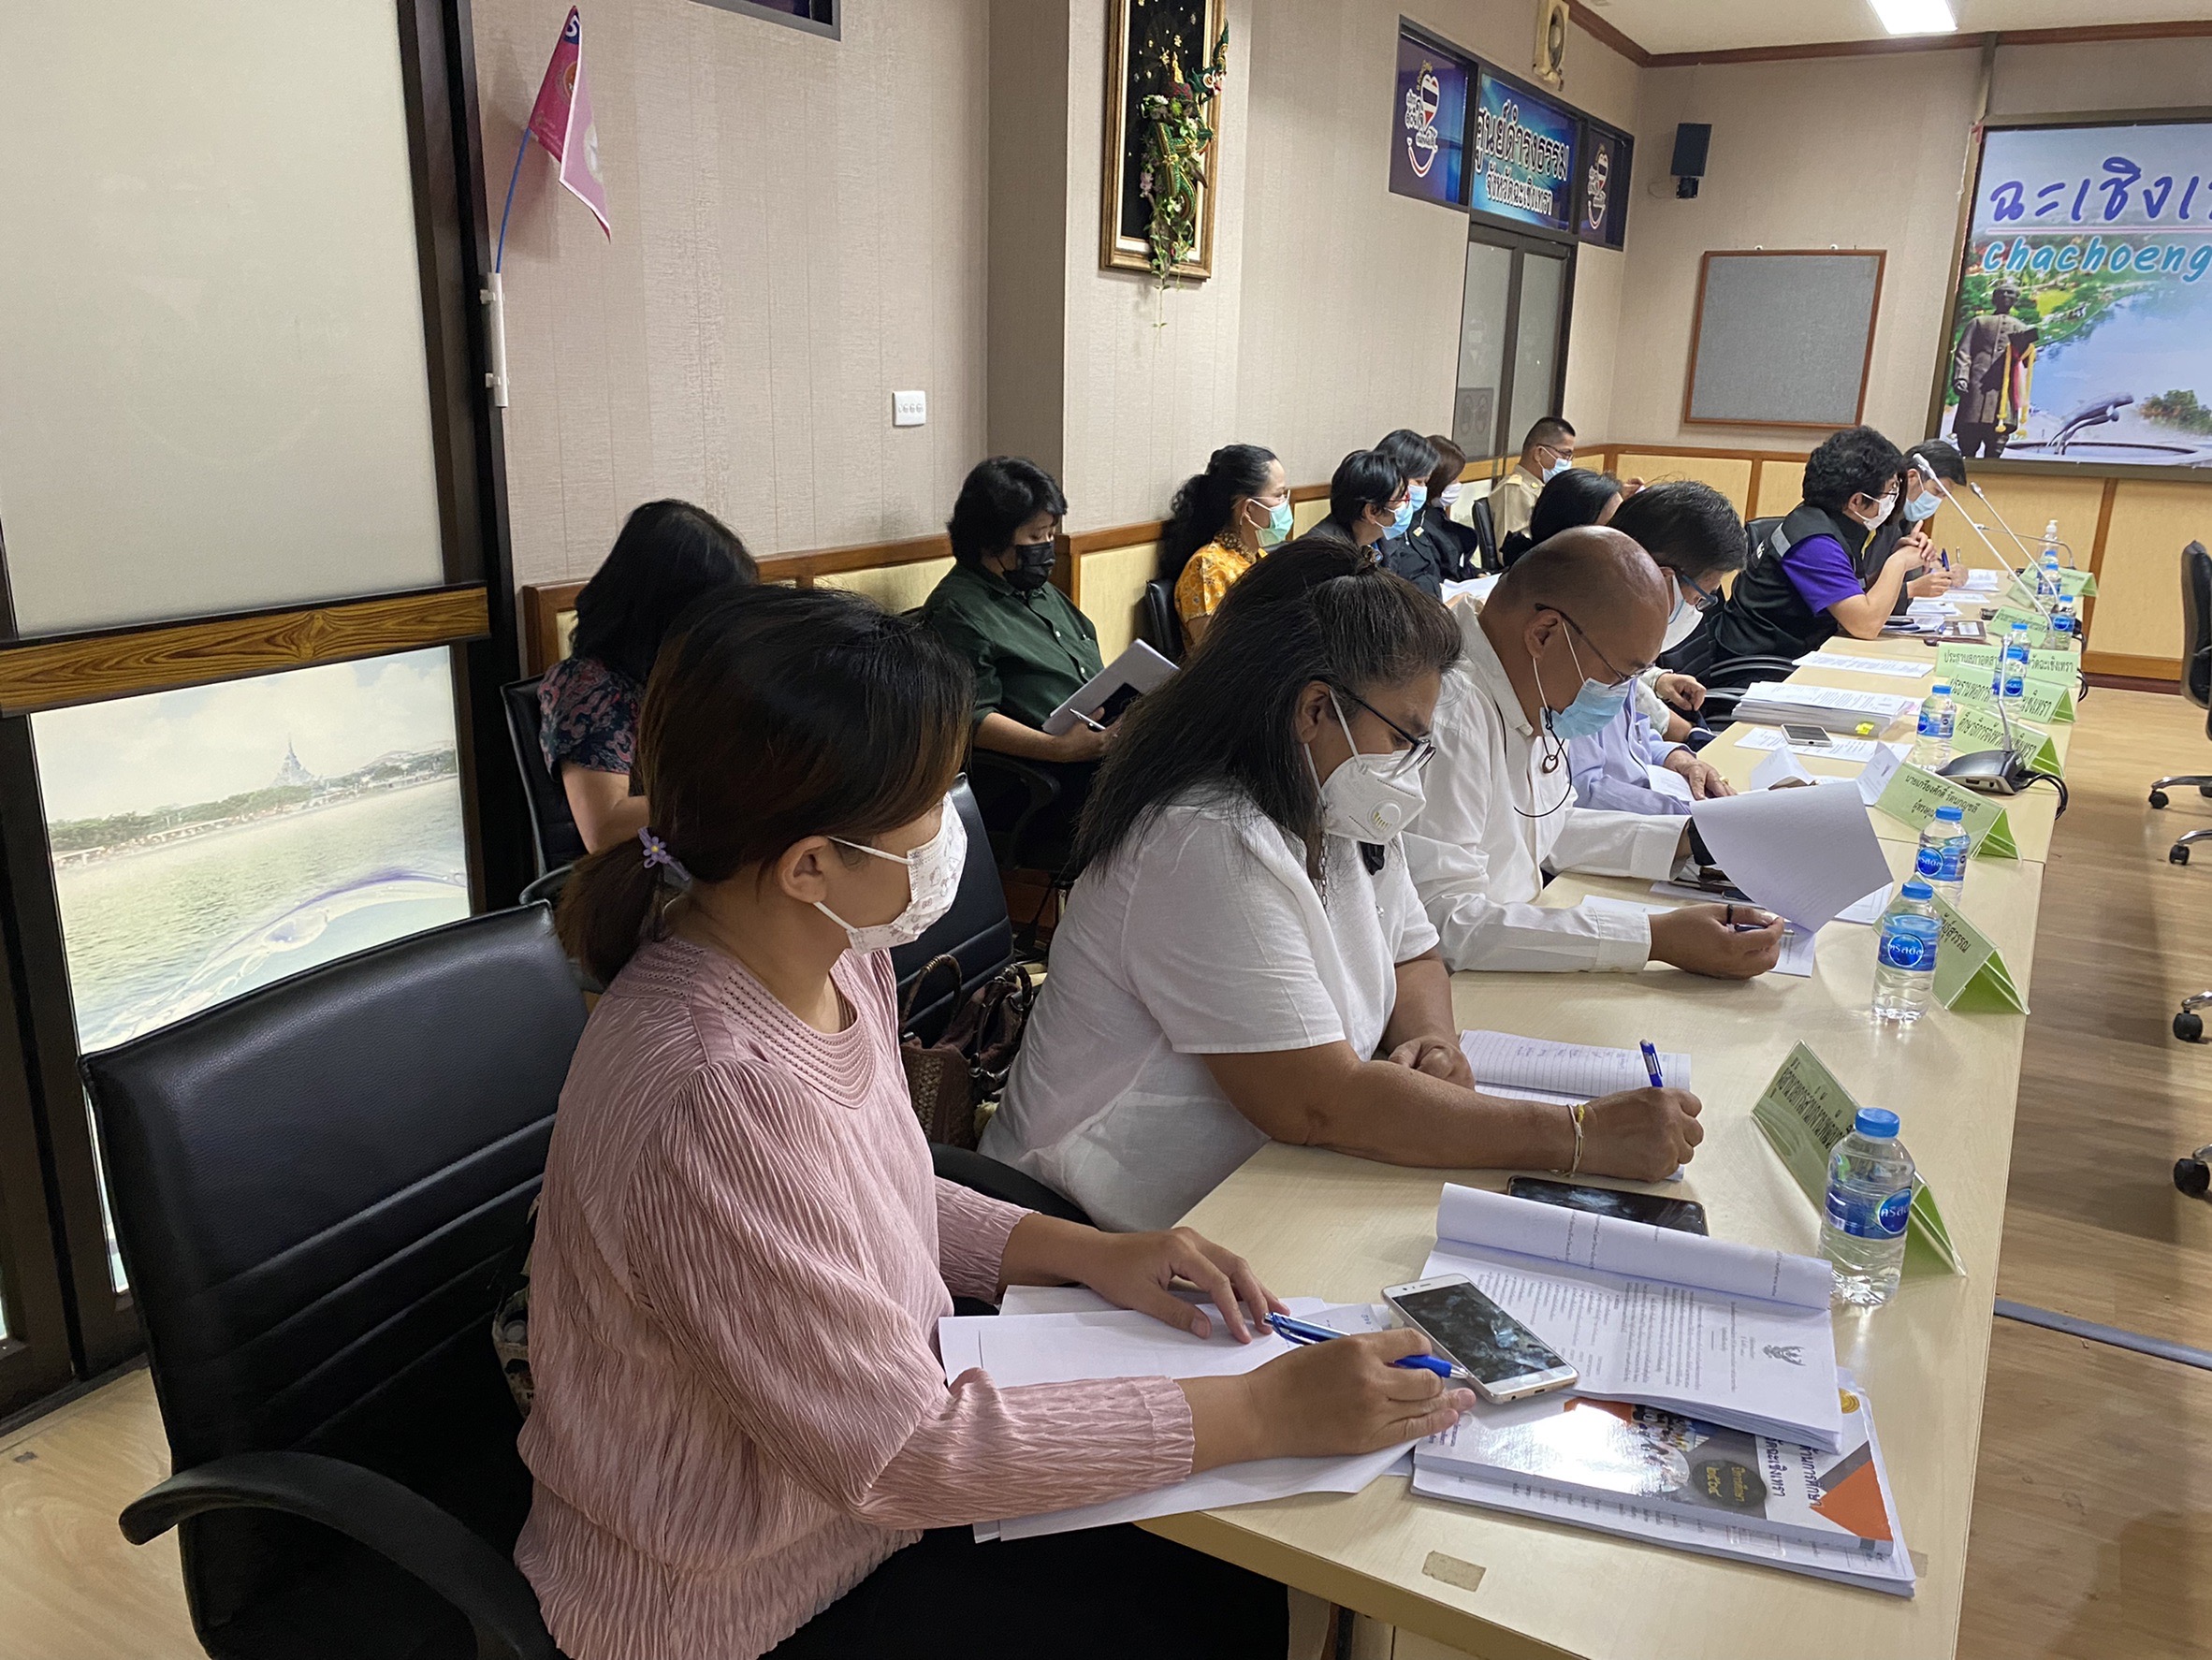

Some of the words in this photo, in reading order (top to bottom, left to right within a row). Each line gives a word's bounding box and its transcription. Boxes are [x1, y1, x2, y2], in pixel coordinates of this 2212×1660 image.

[1475, 98, 1569, 182] ศูนย์ดำรงธรรม
[1486, 160, 1553, 216] จังหวัดฉะเชิงเทรา
[1989, 155, 2212, 222] ฉะเชิงเ
